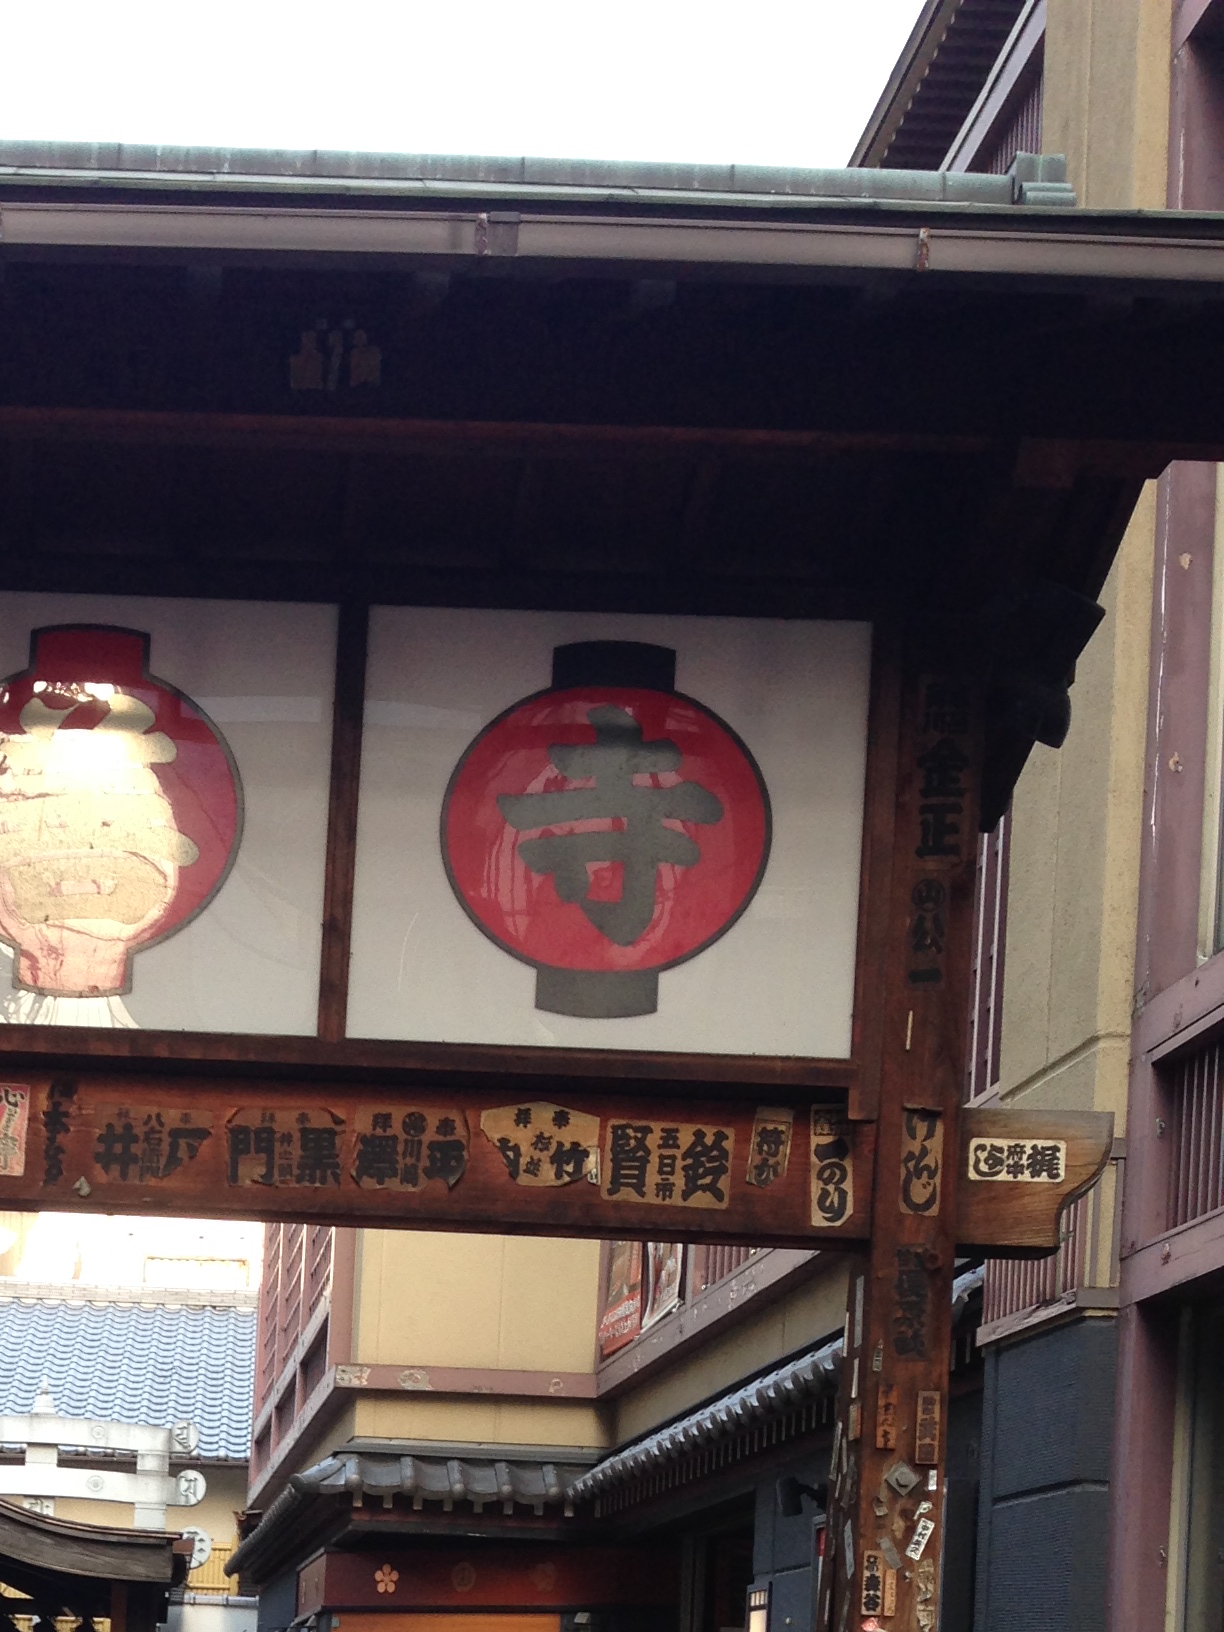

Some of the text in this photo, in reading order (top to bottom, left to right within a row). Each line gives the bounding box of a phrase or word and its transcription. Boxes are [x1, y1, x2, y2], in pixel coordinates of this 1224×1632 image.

[496, 704, 724, 946] 寺
[94, 1122, 140, 1181] 井
[228, 1125, 275, 1186] 門
[296, 1127, 341, 1186] 黒
[550, 1141, 591, 1181] 竹
[607, 1124, 652, 1199] 賢
[655, 1127, 681, 1201] 五日市
